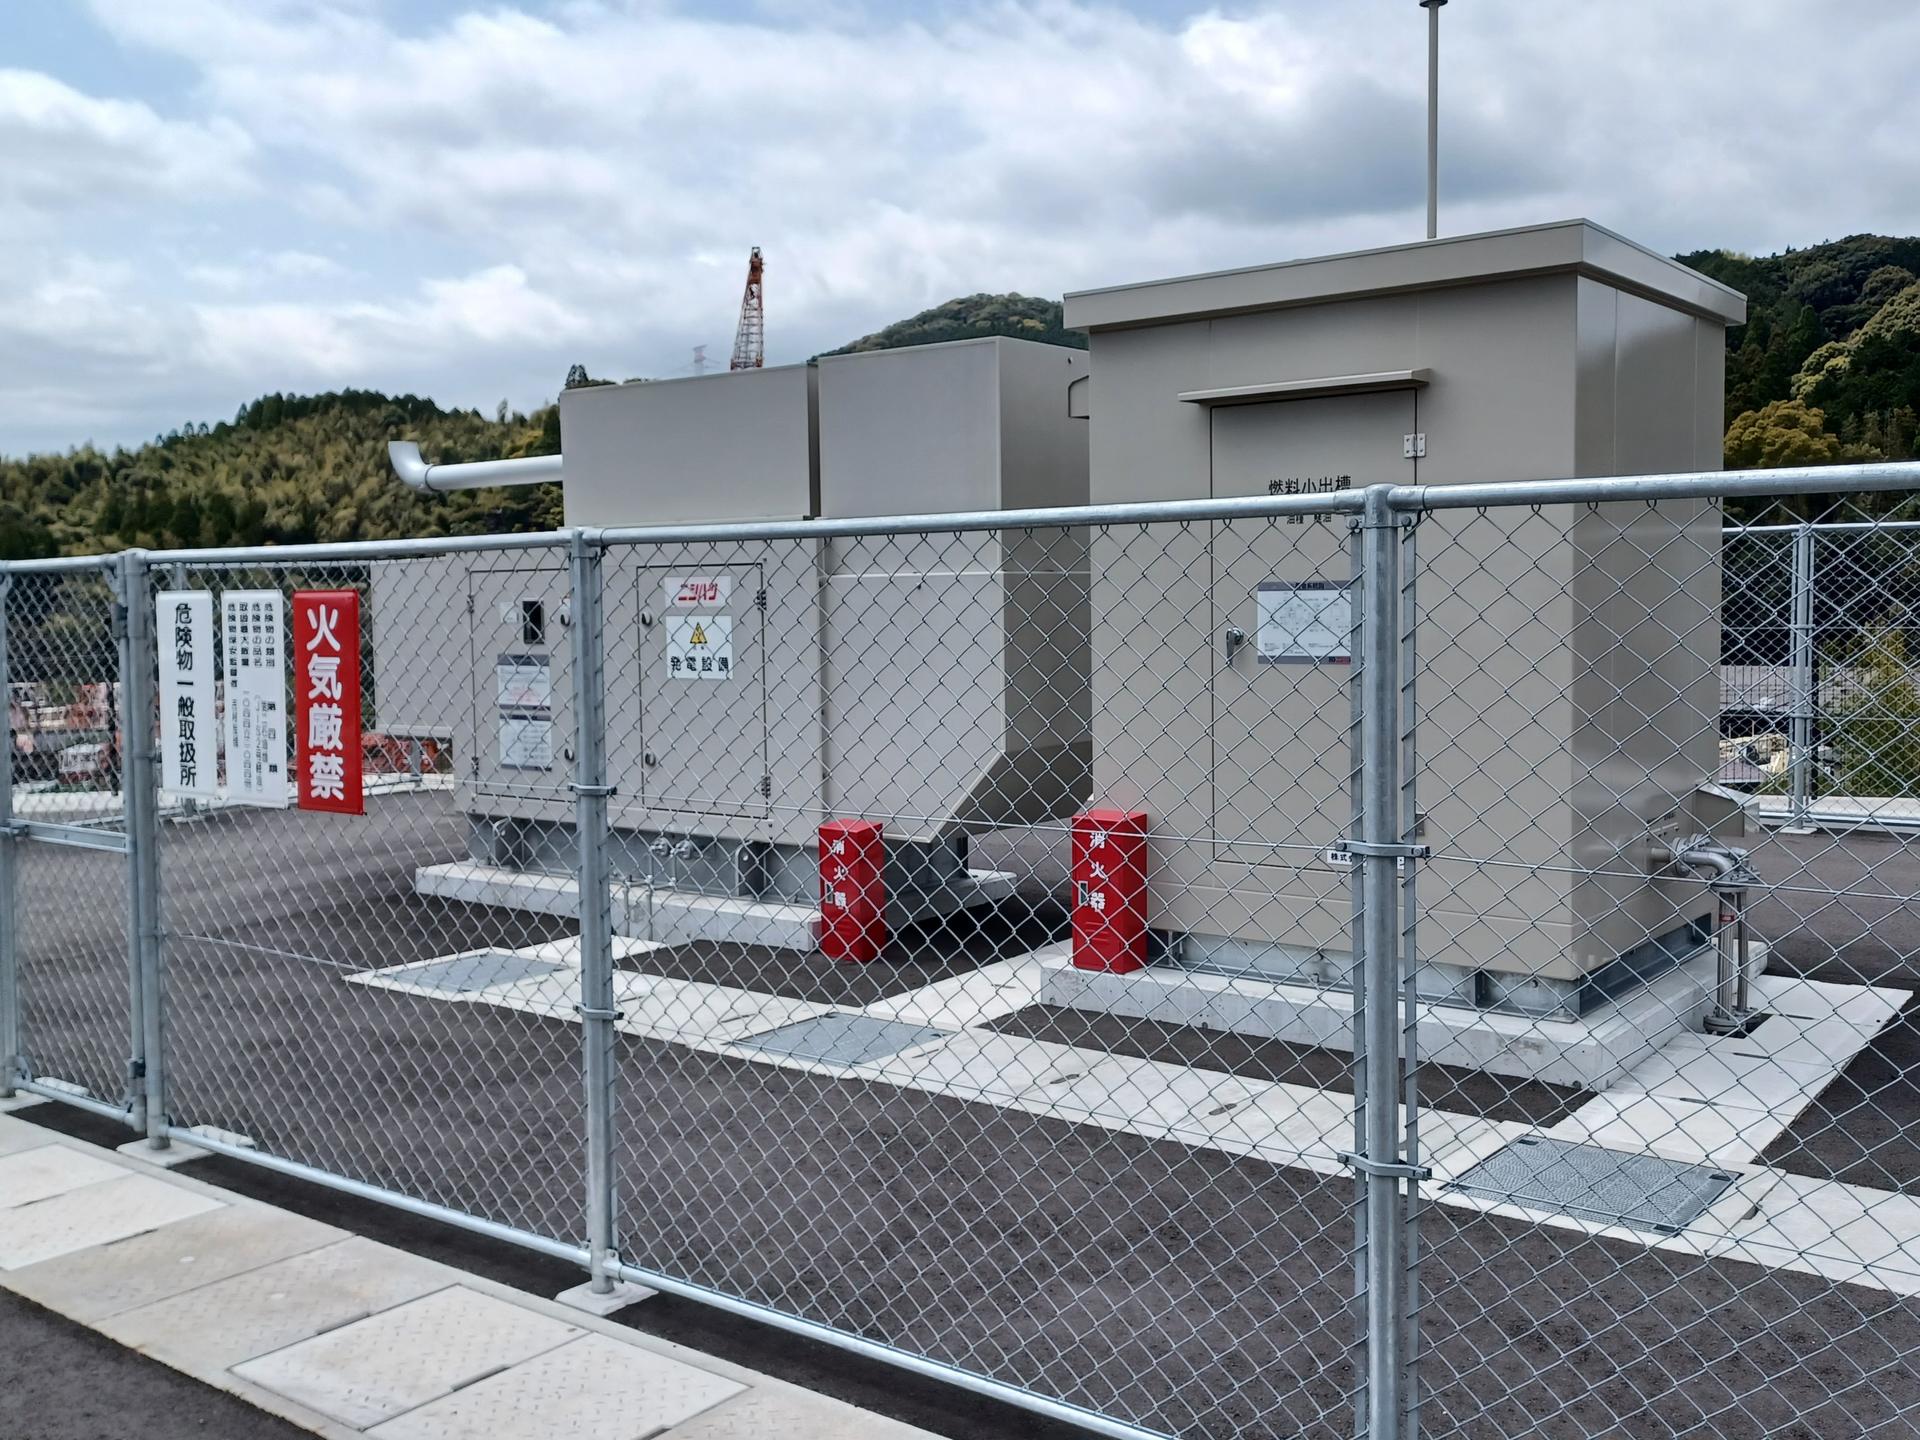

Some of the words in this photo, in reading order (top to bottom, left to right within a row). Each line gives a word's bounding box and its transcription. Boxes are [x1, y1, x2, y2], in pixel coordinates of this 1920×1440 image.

[1268, 474, 1352, 496] 燃料小出槽
[175, 602, 197, 788] 危険物一般取扱所
[306, 603, 345, 801] 火気厳禁
[670, 656, 730, 672] 発電設備
[831, 839, 847, 910] 消火器
[1089, 831, 1107, 913] 消火器
